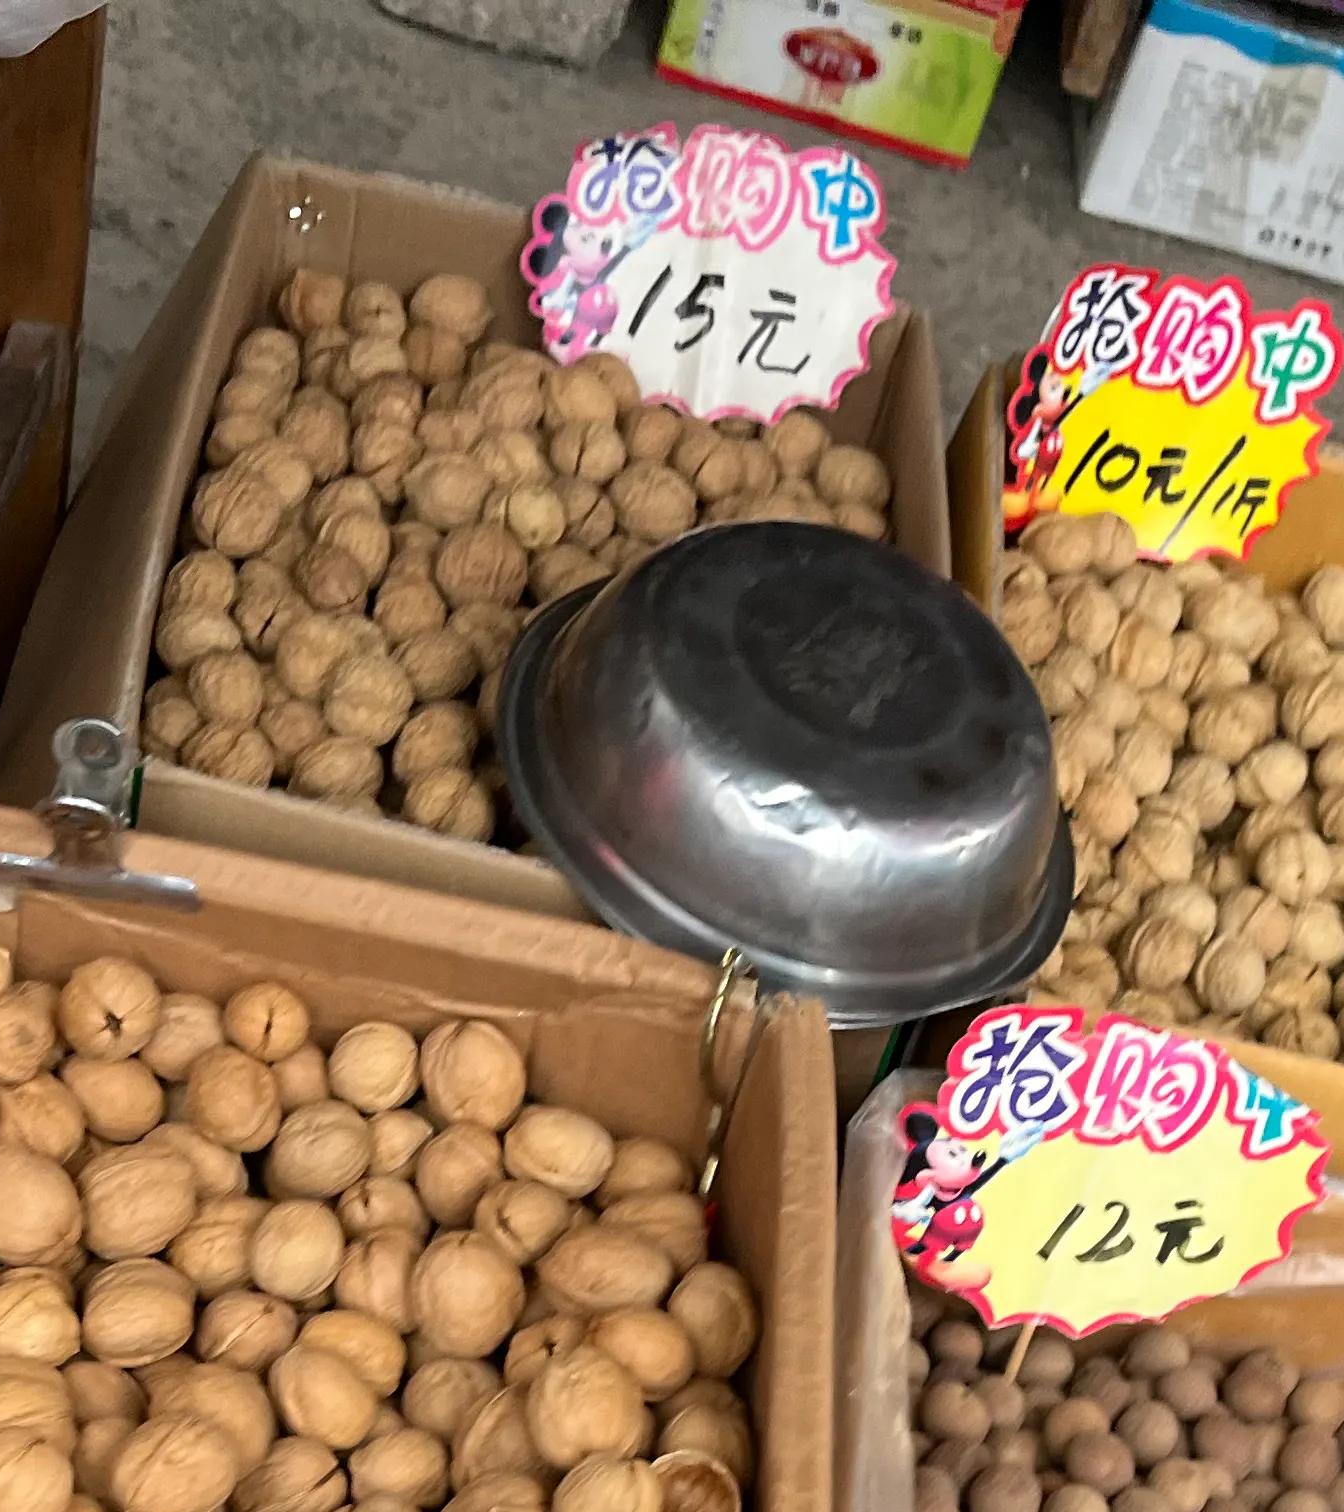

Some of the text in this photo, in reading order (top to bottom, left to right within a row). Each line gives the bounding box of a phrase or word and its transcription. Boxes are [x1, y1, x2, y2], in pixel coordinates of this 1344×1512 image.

[579, 136, 877, 250] 抢购中
[625, 262, 812, 376] 15元
[1061, 276, 1327, 409] 抢购中
[1035, 1200, 1226, 1266] 12元
